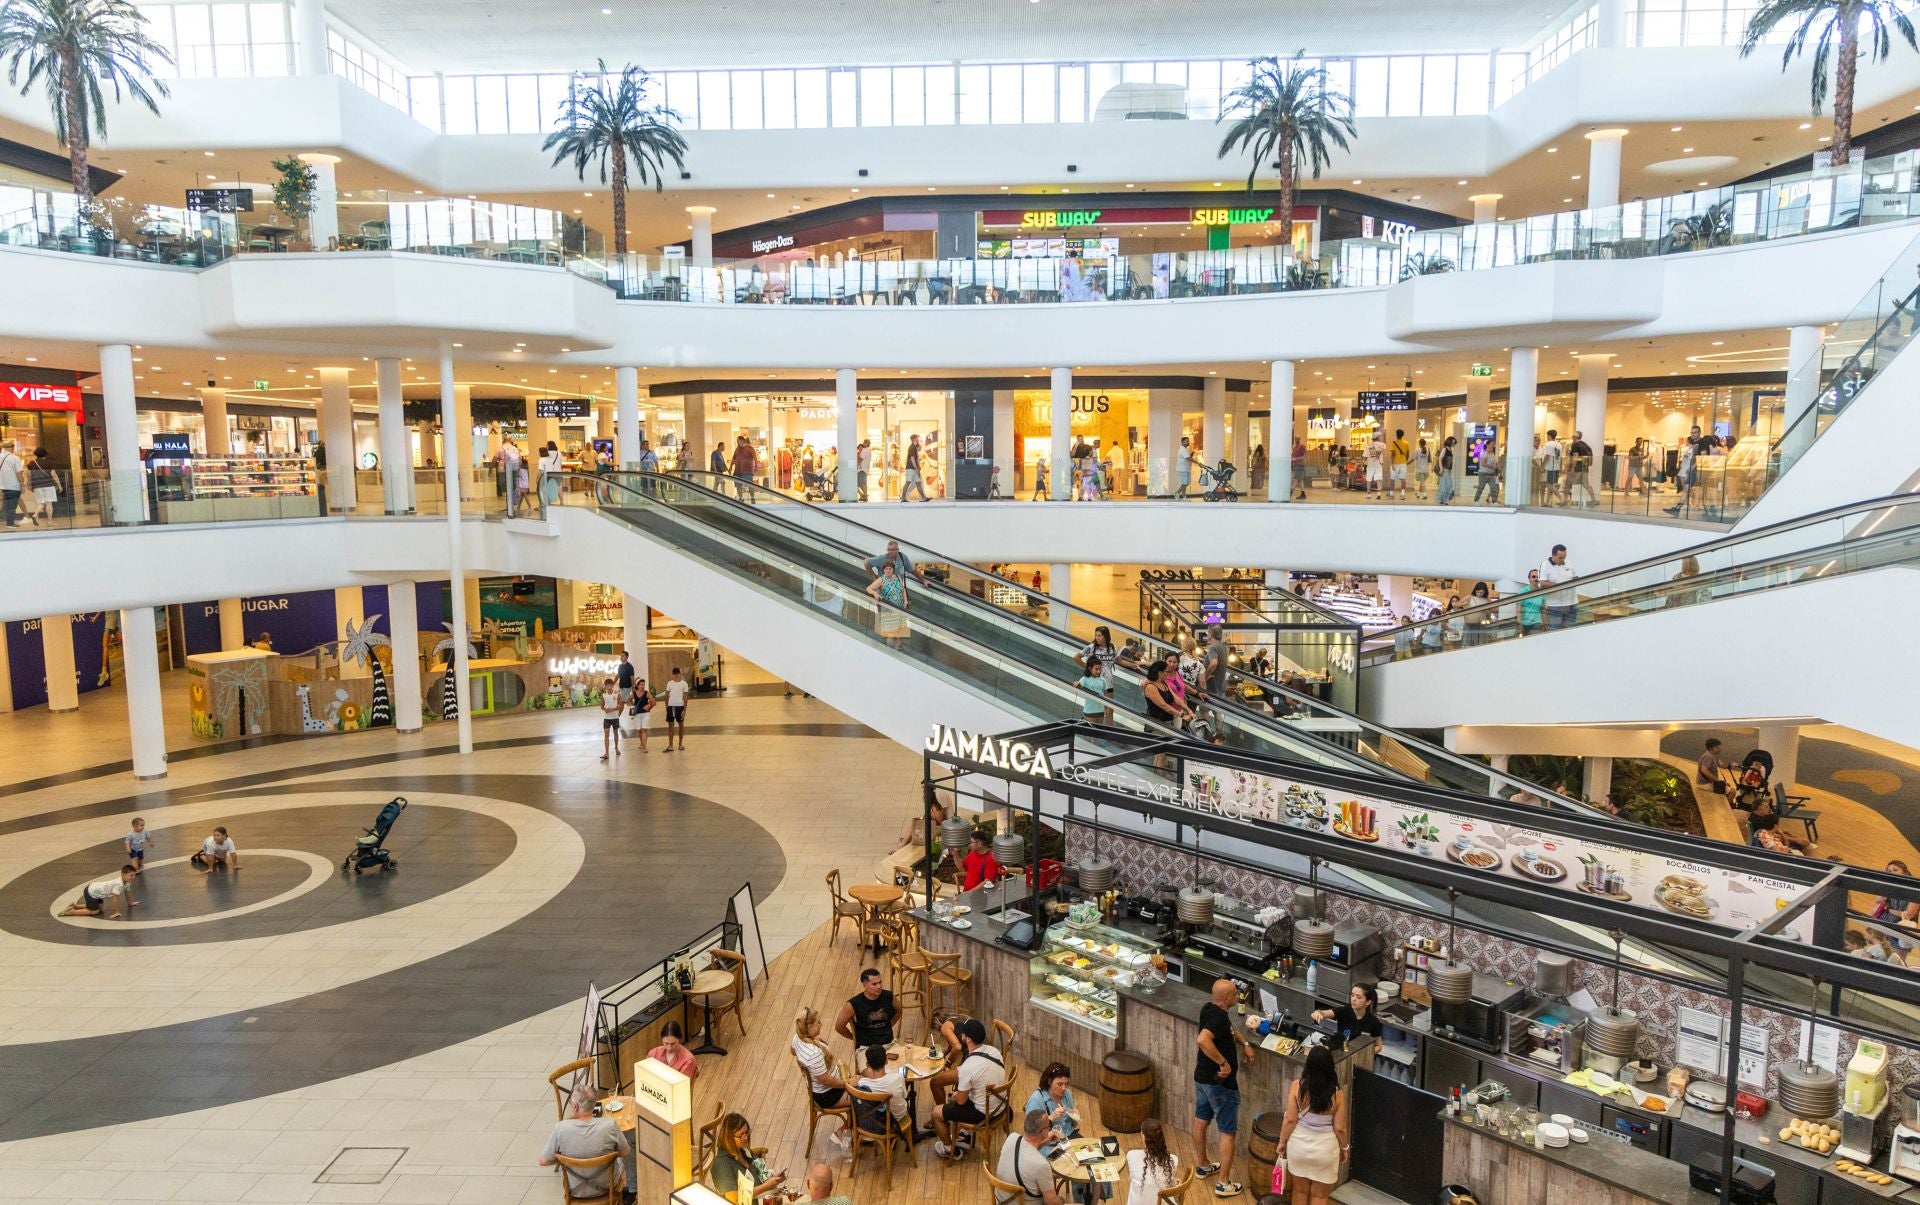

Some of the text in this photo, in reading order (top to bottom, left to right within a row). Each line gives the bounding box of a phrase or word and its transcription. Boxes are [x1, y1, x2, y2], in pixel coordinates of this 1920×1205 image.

[1021, 211, 1101, 228] SUBWAY
[1192, 208, 1274, 226] SUBWAY
[1381, 220, 1416, 248] KFC
[752, 235, 794, 253] Häagen-Dazs
[9, 386, 69, 402] VIPS
[1071, 395, 1109, 412] OUS
[926, 723, 1053, 780] JAMAICA
[1666, 859, 1711, 875] BOCADILLOS
[1748, 875, 1764, 885] PAN
[1765, 878, 1796, 892] CRISTAL
[640, 1083, 668, 1105] JAMAICA
